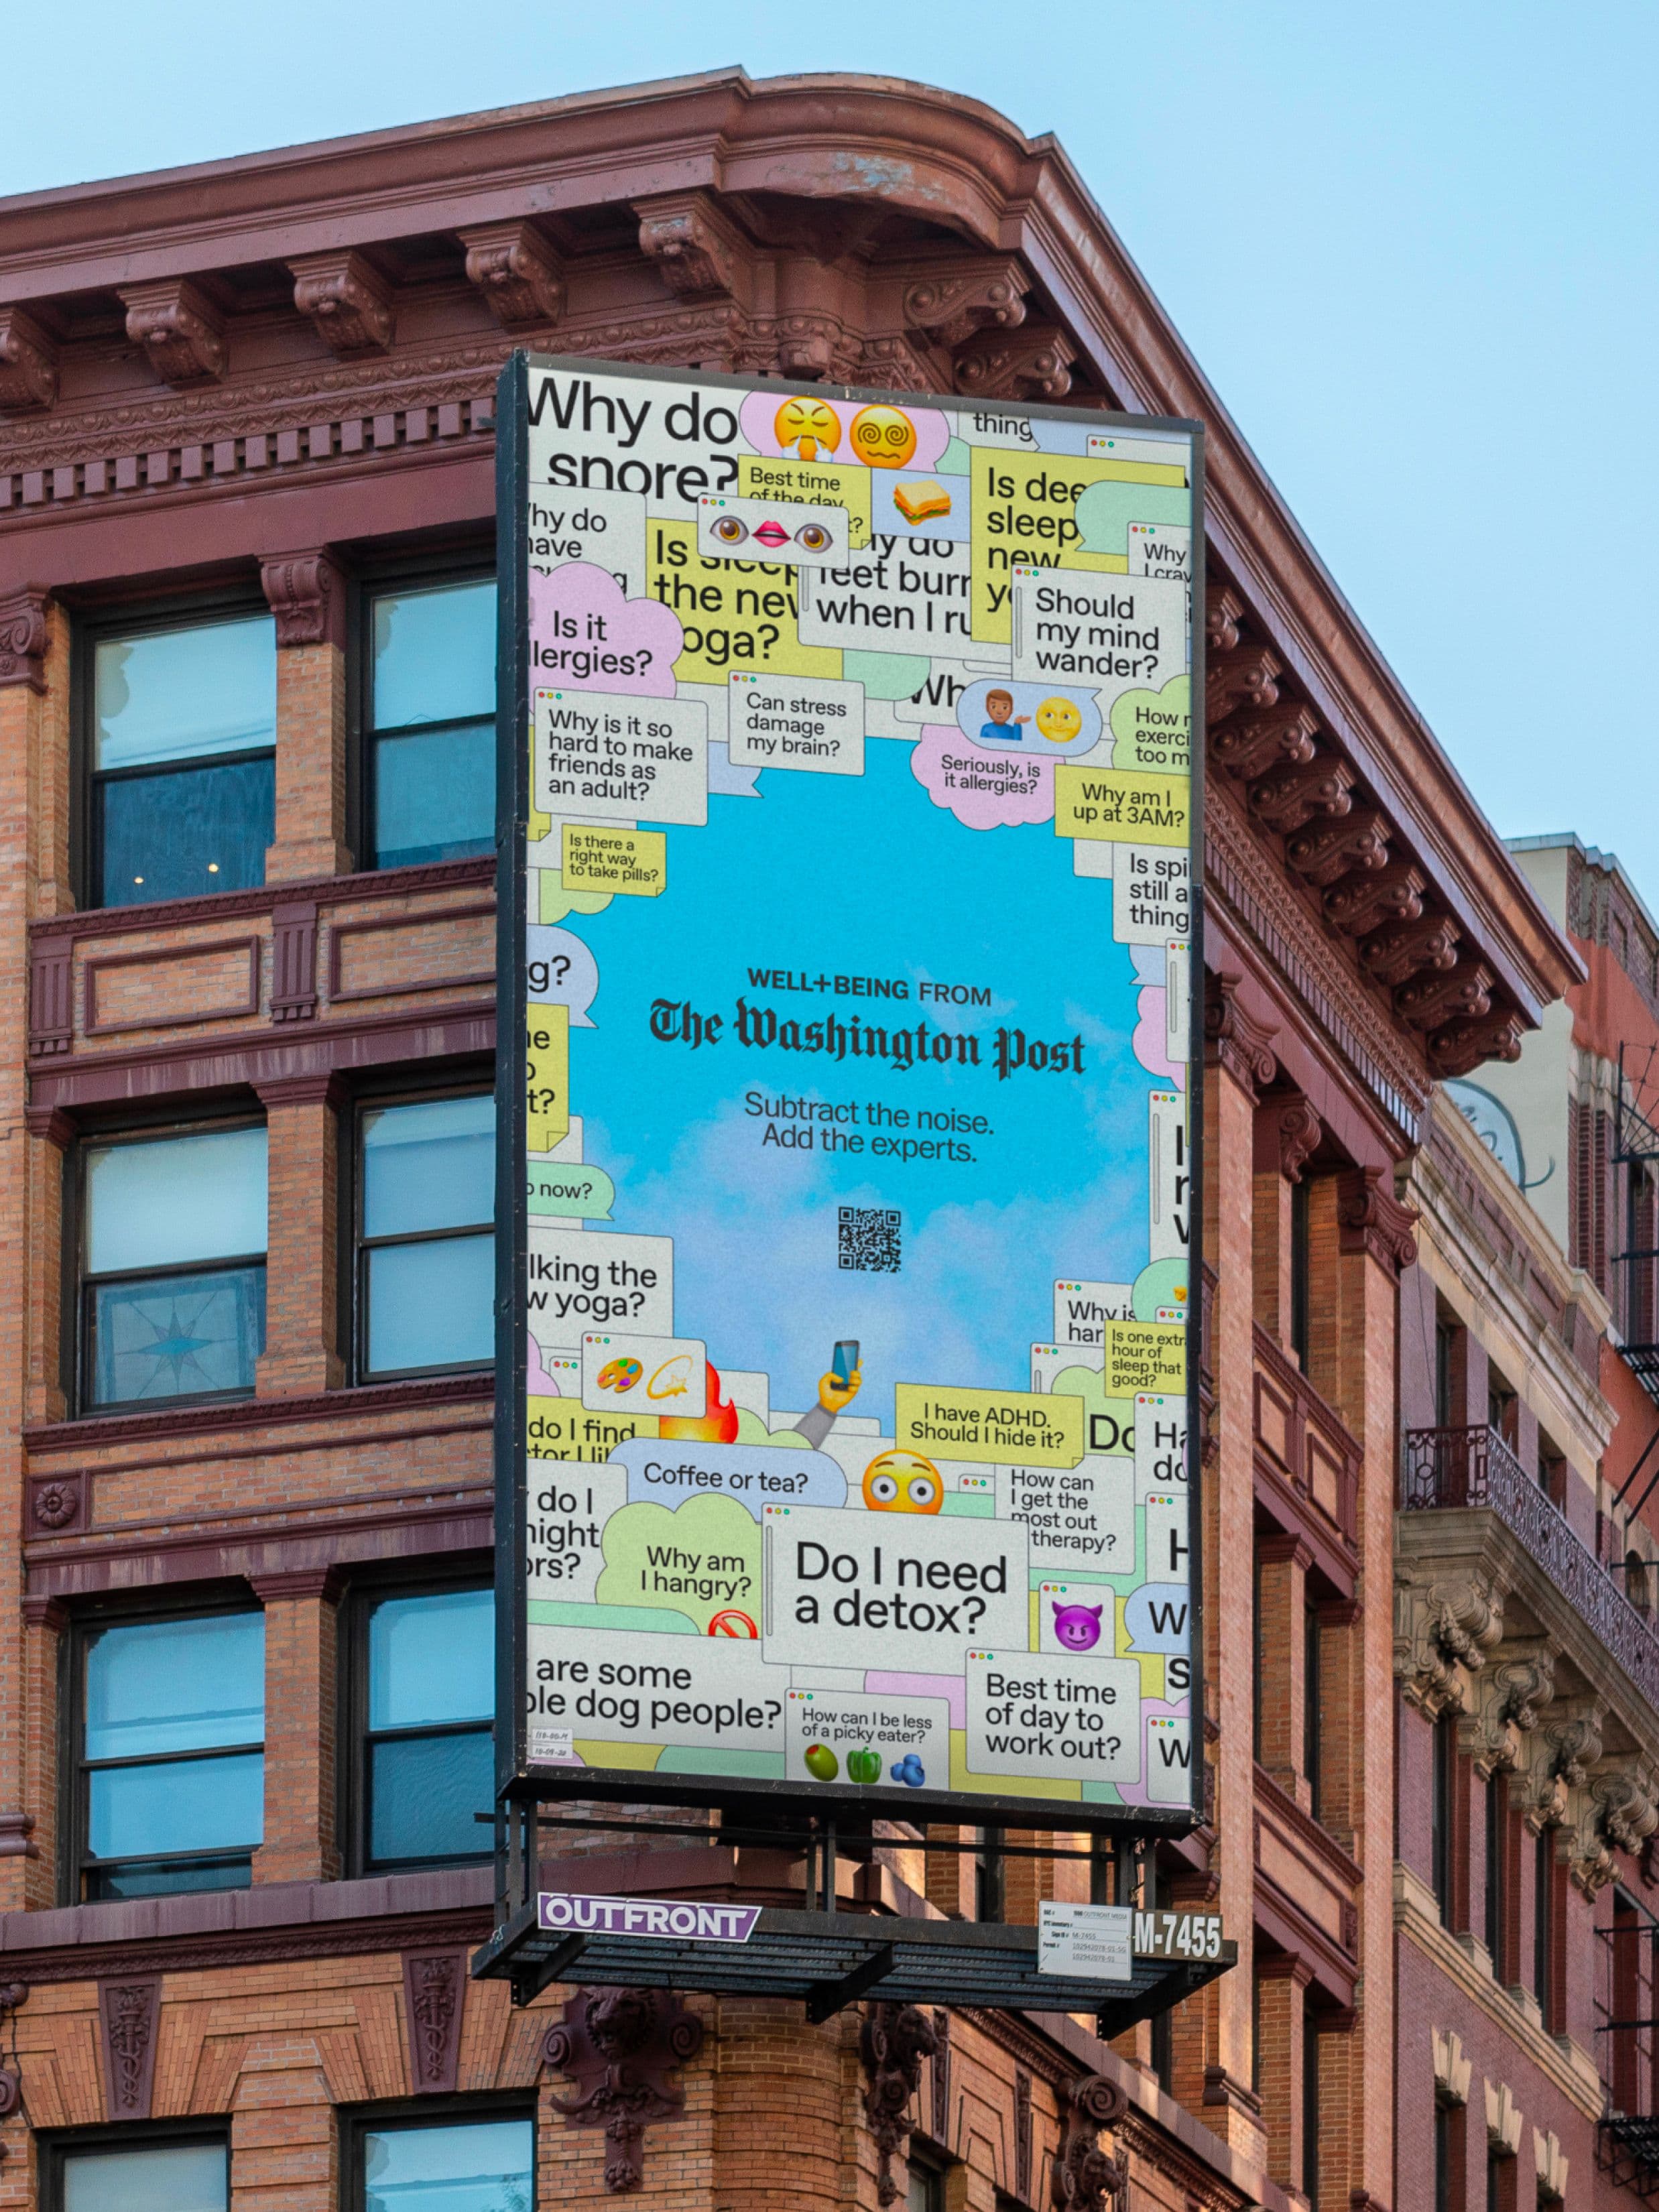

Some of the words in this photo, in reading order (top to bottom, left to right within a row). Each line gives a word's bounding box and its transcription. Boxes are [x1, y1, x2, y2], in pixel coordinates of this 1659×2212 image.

[528, 377, 652, 448] Why
[664, 391, 738, 445] do
[973, 412, 1033, 442] thing
[548, 453, 737, 503] snore?
[750, 467, 792, 486] Best
[798, 471, 840, 491] time
[987, 467, 1015, 499] Is
[572, 507, 607, 533] do
[987, 505, 1079, 546] sleep
[656, 530, 688, 567] Is
[989, 546, 1061, 568] new
[1144, 542, 1186, 566] Why
[654, 573, 723, 612] the
[1036, 588, 1134, 621] Should
[554, 611, 577, 639] Is
[587, 613, 607, 641] it
[816, 594, 914, 631] when
[927, 601, 932, 631] I
[1036, 622, 1081, 651] my
[1089, 622, 1160, 650] mind
[1036, 651, 1159, 679] wander?
[746, 692, 784, 713] Can
[789, 696, 848, 717] stress
[1136, 706, 1179, 726] How
[548, 709, 599, 735] Why
[604, 714, 621, 733] is
[627, 715, 641, 735] it
[647, 721, 673, 739] so
[746, 714, 825, 739] damage
[549, 731, 598, 753] hard
[603, 735, 627, 756] to
[633, 739, 693, 762] make
[746, 738, 776, 757] my
[782, 736, 841, 757] brain?
[1135, 730, 1190, 747] exerci
[549, 754, 625, 778] friends
[631, 764, 656, 780] as
[941, 755, 1024, 779] Seriously,
[1028, 760, 1041, 778] is
[1135, 746, 1167, 764] too
[549, 780, 574, 796] an
[581, 780, 650, 802] adult?
[944, 772, 957, 788] it
[961, 774, 1037, 796] allergies?
[1082, 783, 1127, 809] Why
[1130, 792, 1160, 806] am
[1166, 791, 1170, 807] I
[1074, 806, 1099, 823] up
[1103, 807, 1121, 823] at
[1127, 806, 1184, 828] 3AM?
[570, 834, 582, 847] Is
[586, 835, 622, 850] there
[626, 841, 635, 851] a
[570, 849, 603, 865] right
[607, 855, 636, 869] way
[1130, 853, 1148, 873] Is
[569, 863, 585, 875] to
[589, 865, 619, 879] take
[623, 869, 659, 883] pills?
[1130, 880, 1168, 902] still
[1176, 887, 1188, 904] a
[1129, 905, 1190, 934] thing
[528, 955, 571, 993] g?
[748, 967, 909, 1000] WELL+BEING
[919, 983, 991, 1007] FROM
[650, 997, 724, 1050] The
[734, 995, 982, 1071] Washington
[993, 1026, 1086, 1081] Post
[745, 1091, 859, 1125] Subtract
[865, 1101, 910, 1129] the
[918, 1108, 995, 1135] noise.
[762, 1122, 814, 1150] Add
[820, 1129, 865, 1153] the
[871, 1135, 977, 1164] experts.
[540, 1182, 593, 1200] now?
[530, 1253, 599, 1291] lking
[607, 1260, 657, 1288] the
[556, 1291, 646, 1323] yoga?
[1068, 1300, 1117, 1321] Why
[1068, 1323, 1103, 1343] har
[1112, 1329, 1123, 1342] Is
[1127, 1333, 1154, 1345] one
[1112, 1343, 1145, 1358] hour
[1148, 1346, 1163, 1359] of
[1112, 1359, 1149, 1375] sleep
[1153, 1361, 1182, 1375] that
[1112, 1374, 1156, 1388] good?
[924, 1402, 928, 1419] I
[934, 1404, 980, 1423] have
[985, 1407, 1051, 1428] ADHD.
[528, 1416, 562, 1439] do
[570, 1418, 574, 1440] I
[583, 1419, 635, 1443] find
[911, 1422, 978, 1444] Should
[985, 1426, 989, 1445] I
[995, 1427, 1036, 1447] hide
[1042, 1429, 1064, 1449] it?
[644, 1463, 723, 1487] Coffee
[729, 1474, 753, 1490] or
[759, 1473, 809, 1494] tea?
[1011, 1469, 1055, 1487] How
[1060, 1477, 1094, 1491] can
[538, 1485, 577, 1514] do
[587, 1487, 593, 1514] I
[1011, 1488, 1015, 1505] I
[1022, 1492, 1052, 1511] get
[1057, 1492, 1089, 1510] the
[1011, 1512, 1060, 1528] most
[1065, 1515, 1098, 1531] out
[1032, 1530, 1116, 1554] therapy?
[647, 1546, 701, 1574] Why
[707, 1556, 745, 1573] am
[796, 1540, 859, 1584] Do
[873, 1547, 881, 1585] I
[898, 1556, 1007, 1593] need
[641, 1570, 646, 1591] I
[654, 1571, 751, 1601] hangry?
[796, 1595, 820, 1624] a
[833, 1589, 986, 1635] detox?
[1148, 1601, 1187, 1635] W
[536, 1658, 589, 1683] are
[599, 1662, 691, 1690] some
[987, 1674, 1048, 1699] Best
[1054, 1678, 1117, 1705] time
[576, 1689, 639, 1728] dog
[652, 1699, 782, 1733] people?
[802, 1708, 838, 1725] How
[841, 1713, 869, 1727] can
[872, 1711, 876, 1727] I
[880, 1713, 900, 1728] be
[904, 1713, 932, 1730] less
[985, 1704, 1015, 1725] of
[1020, 1705, 1068, 1735] day
[1074, 1709, 1104, 1732] to
[802, 1723, 819, 1738] of
[821, 1727, 831, 1737] a
[834, 1725, 874, 1743] picky
[877, 1729, 926, 1744] eater?
[985, 1733, 1054, 1758] work
[1060, 1735, 1121, 1761] out?
[545, 1897, 747, 1937] OUTFRONT
[1135, 1912, 1221, 1959] M-7455
